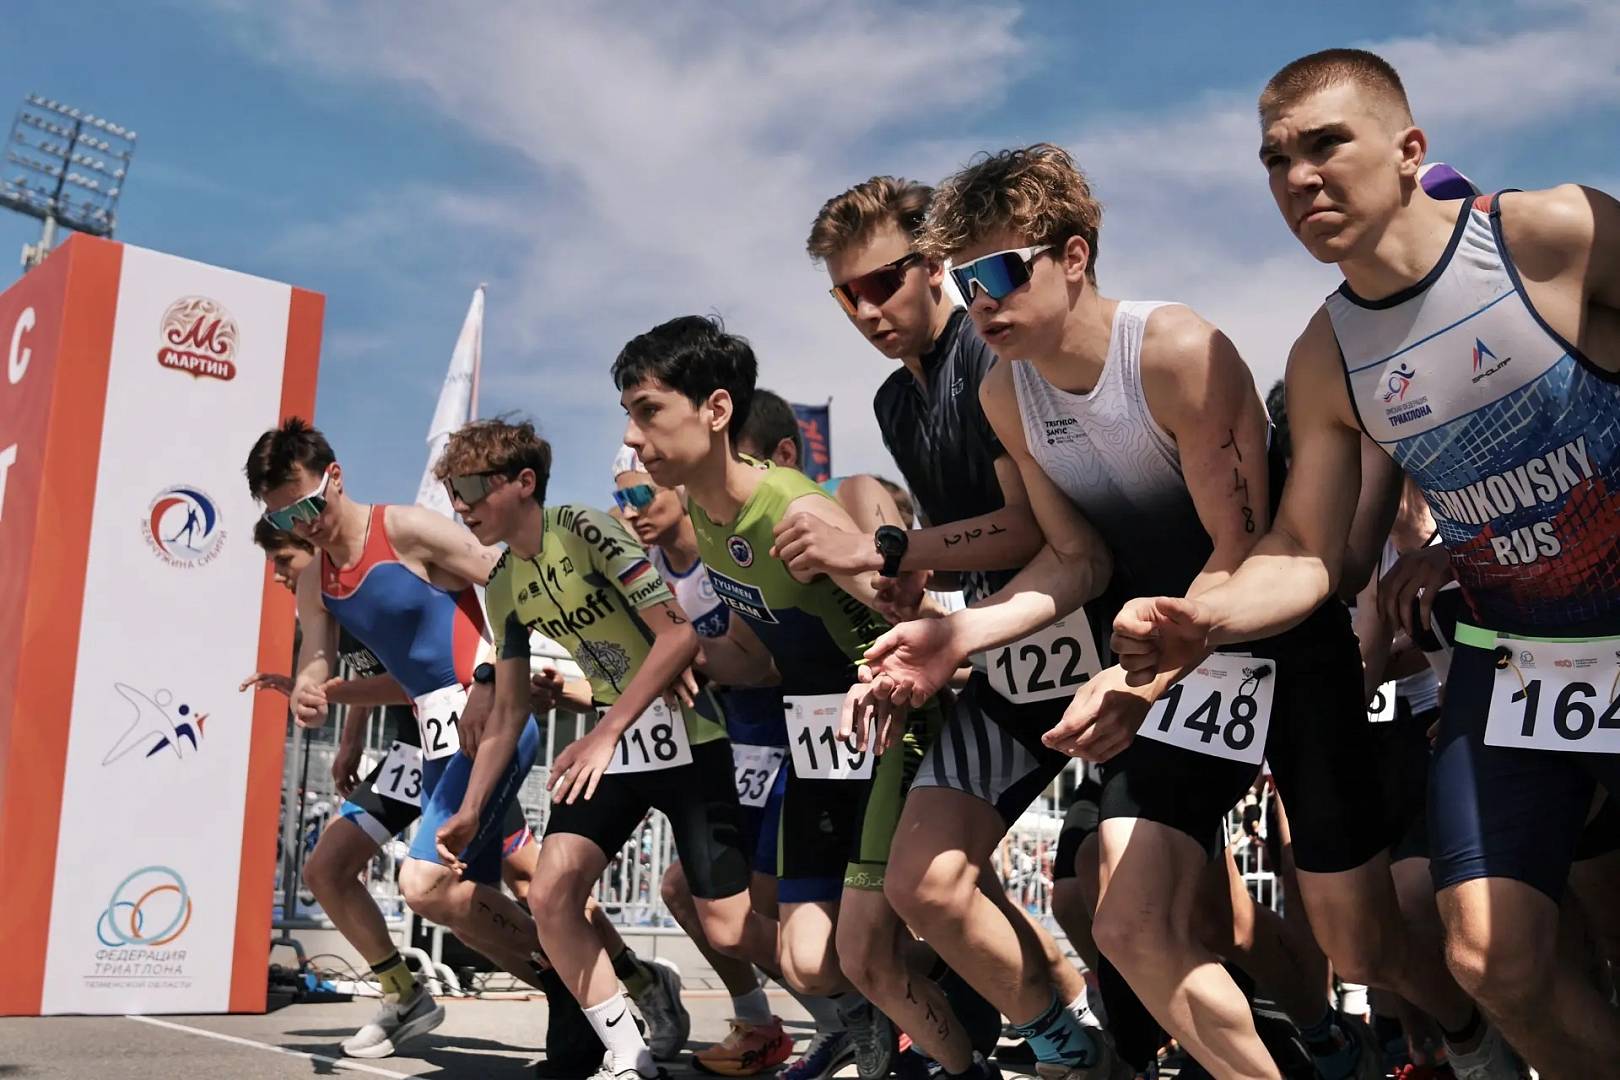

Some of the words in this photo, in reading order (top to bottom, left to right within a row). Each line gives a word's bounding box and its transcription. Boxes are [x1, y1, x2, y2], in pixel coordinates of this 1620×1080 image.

[164, 350, 229, 377] МАРТИН
[1389, 404, 1432, 427] ТРИАТЛОНА
[557, 504, 624, 561] Tinkoff
[1491, 521, 1561, 566] RUS
[628, 575, 663, 604] Tinko
[713, 576, 753, 600] TYUMEN
[526, 589, 615, 638] Tinkoff
[719, 594, 763, 619] TEAM
[997, 636, 1091, 695] 122
[1156, 683, 1258, 750] 148
[621, 723, 678, 766] 118
[798, 725, 865, 771] 119
[95, 949, 187, 962] ФЕДЕРАЦИЯ
[95, 963, 183, 975] ТРИАТЛОНА
